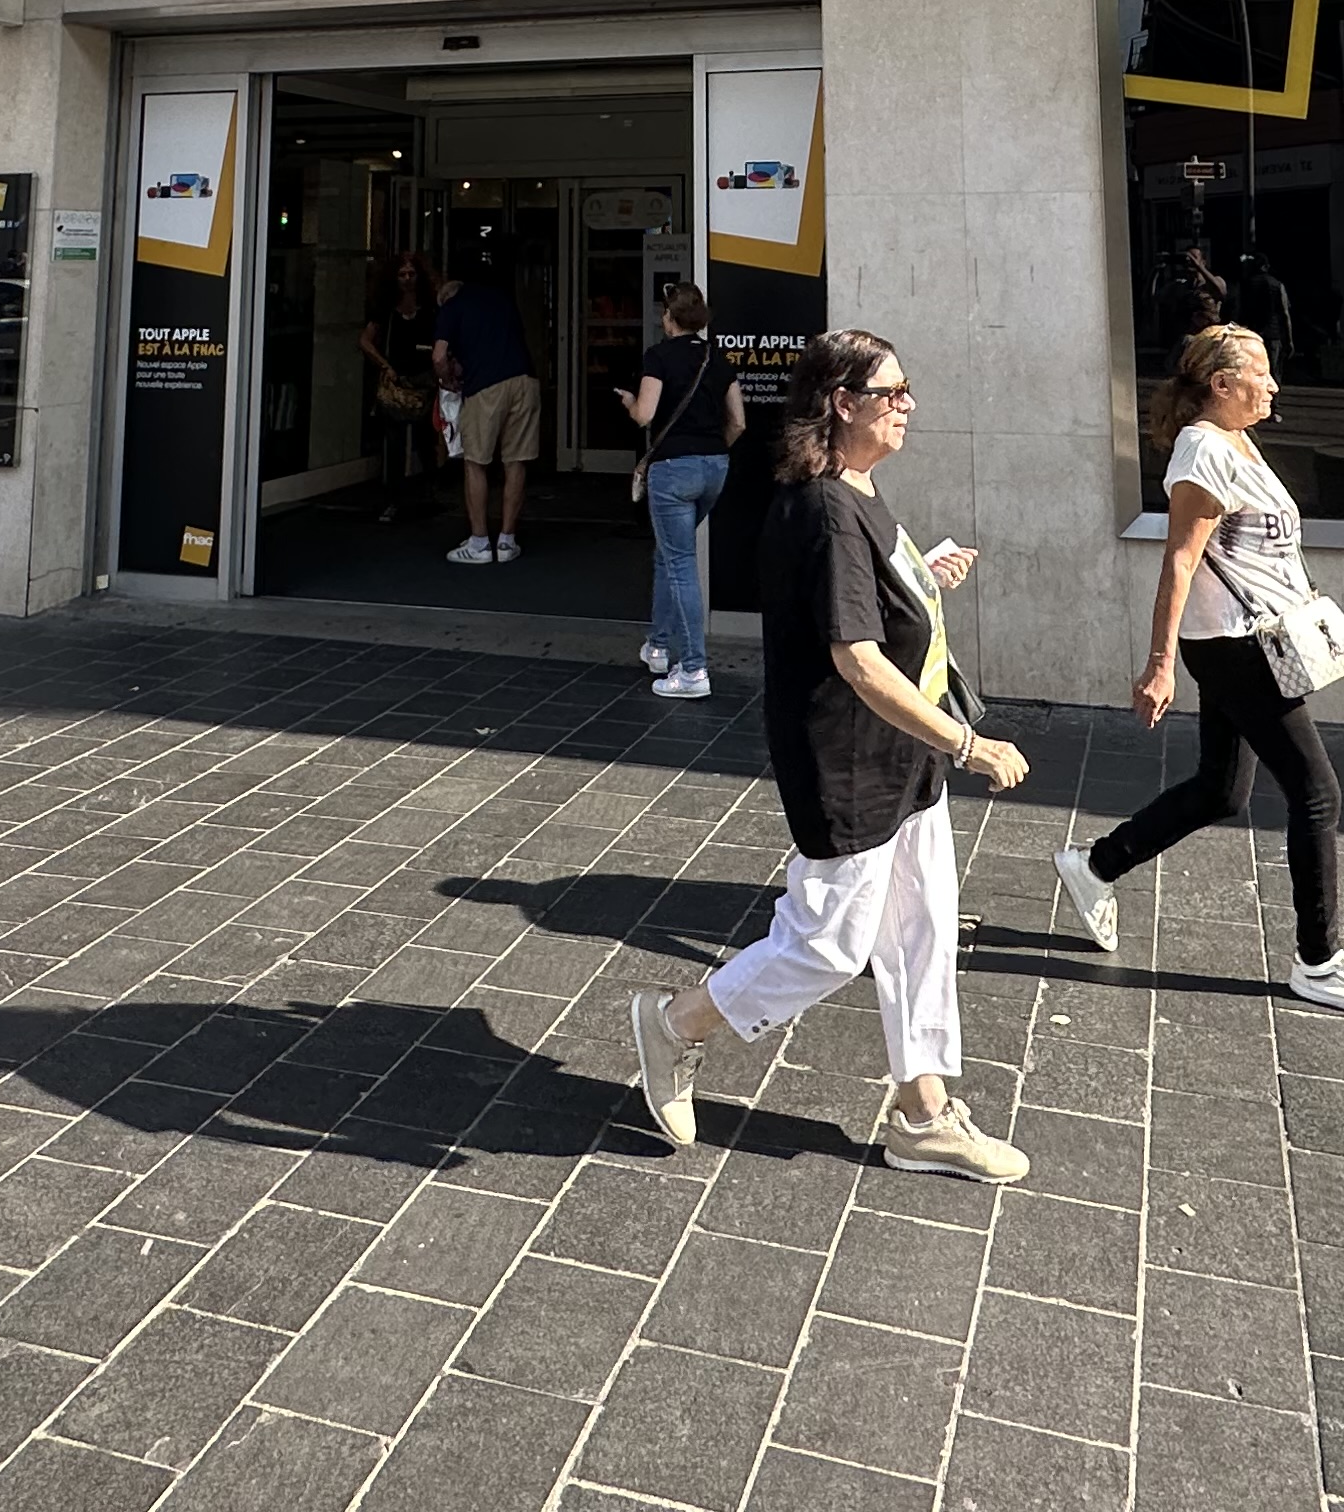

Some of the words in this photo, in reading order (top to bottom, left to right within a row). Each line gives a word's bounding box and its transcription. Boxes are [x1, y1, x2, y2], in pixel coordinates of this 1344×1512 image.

[138, 328, 171, 340] TOUT
[172, 328, 210, 341] APPLE
[716, 334, 756, 348] TOUT
[759, 335, 805, 349] APPLE
[138, 343, 161, 355] EST
[162, 340, 171, 355] À
[174, 343, 190, 355] LA
[193, 343, 224, 356] FNAC
[725, 350, 744, 365] ST
[747, 349, 758, 365] À
[762, 352, 782, 365] LA
[187, 361, 207, 370] Apple
[183, 532, 214, 546] fnac
